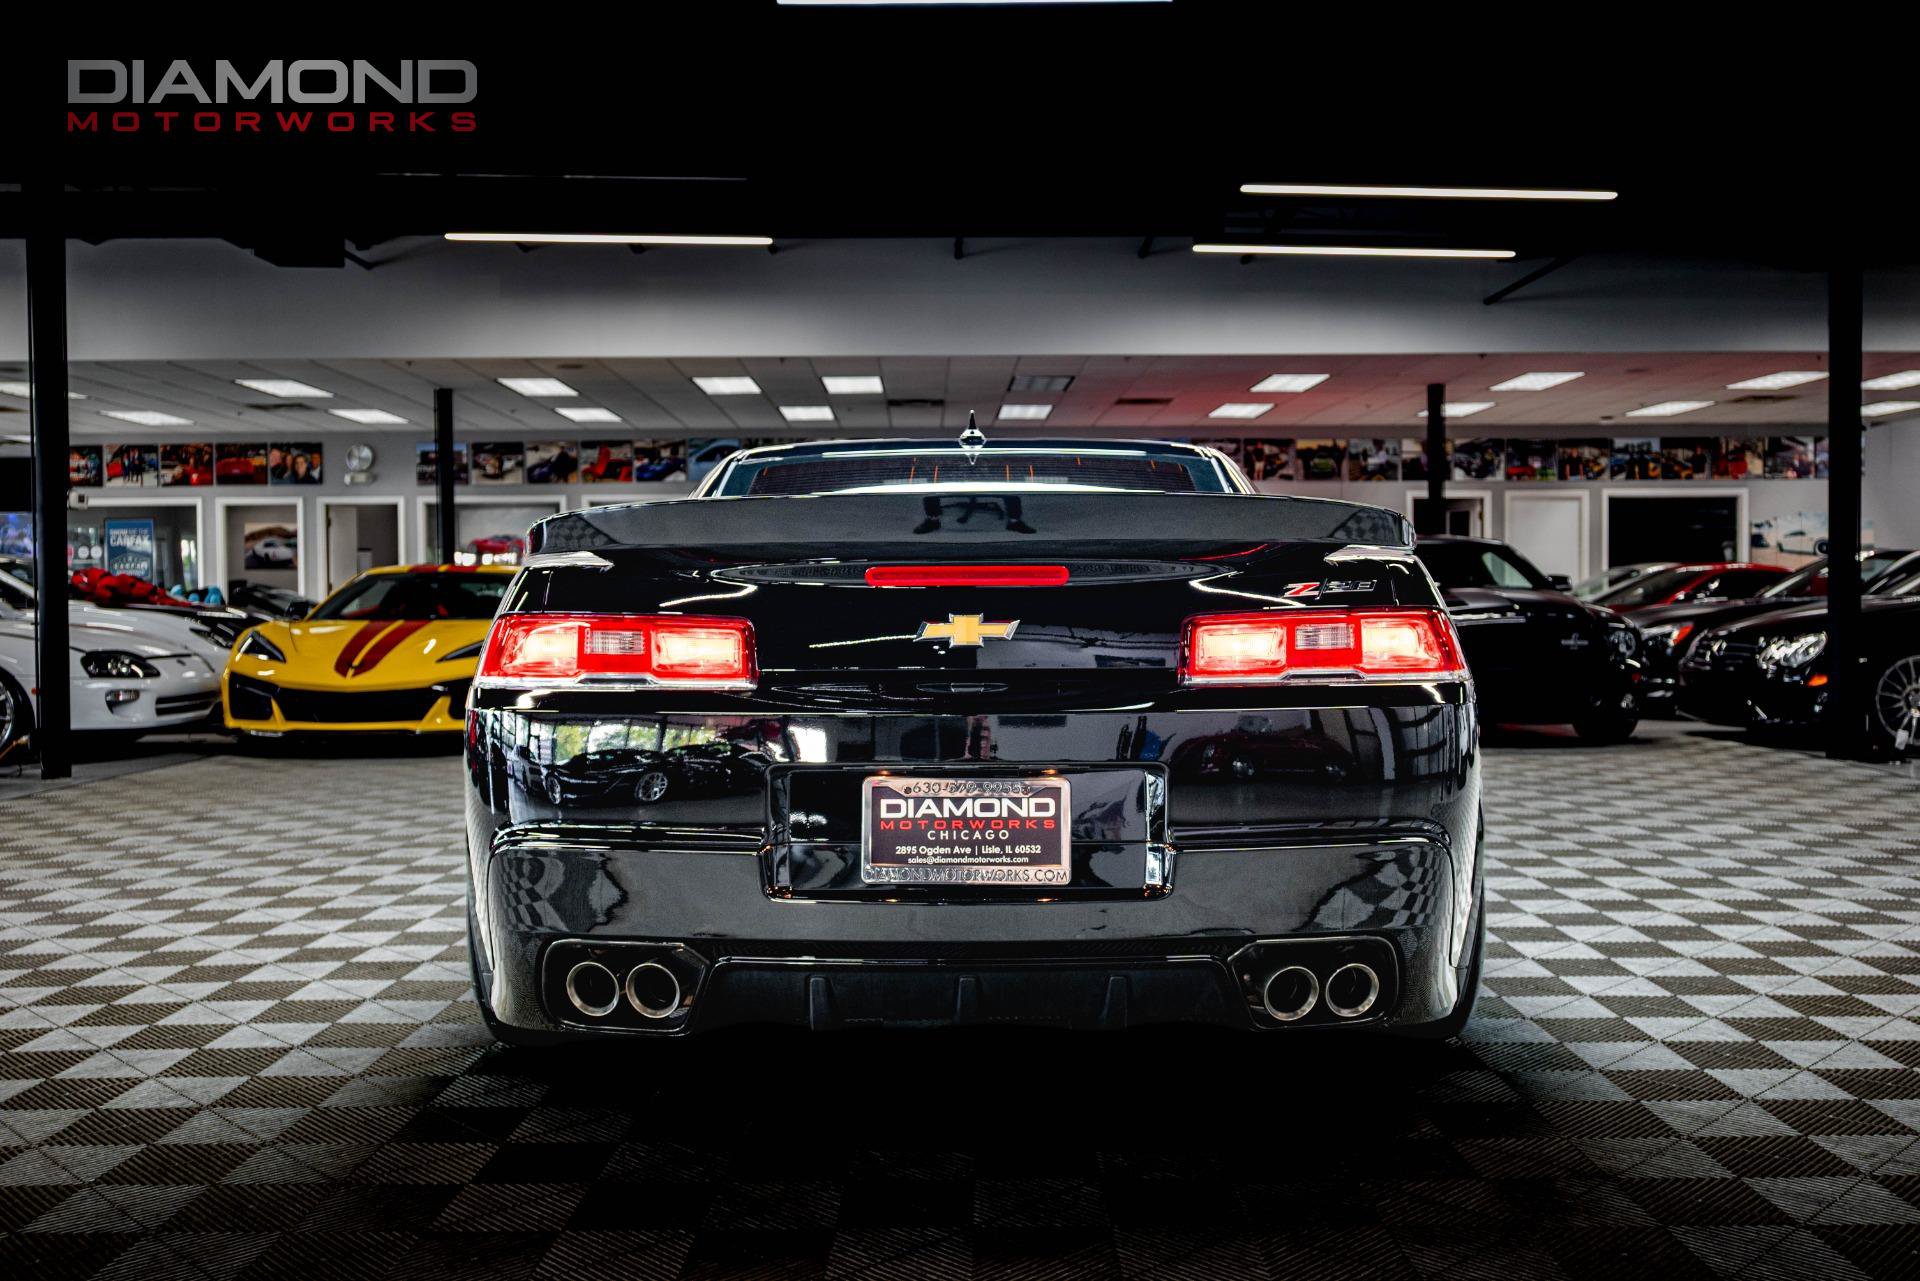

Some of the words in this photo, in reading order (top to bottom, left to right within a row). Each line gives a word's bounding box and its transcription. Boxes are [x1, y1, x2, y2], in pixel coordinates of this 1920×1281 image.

[110, 535, 150, 547] CARFAX
[880, 797, 1056, 819] DIAMOND
[880, 819, 1055, 830] MOTORWORKS
[927, 830, 1009, 840] CHICAGO
[895, 845, 917, 855] 2895
[919, 845, 951, 856] Ogden
[953, 845, 972, 854] Ave
[981, 845, 1003, 855] Lisle,
[1005, 845, 1013, 854] IL
[1015, 844, 1041, 854] 60532
[907, 855, 1029, 865] sales@diamondmotorworks.com
[864, 868, 1068, 882] DIAMONDMOTORWORKS.COM
